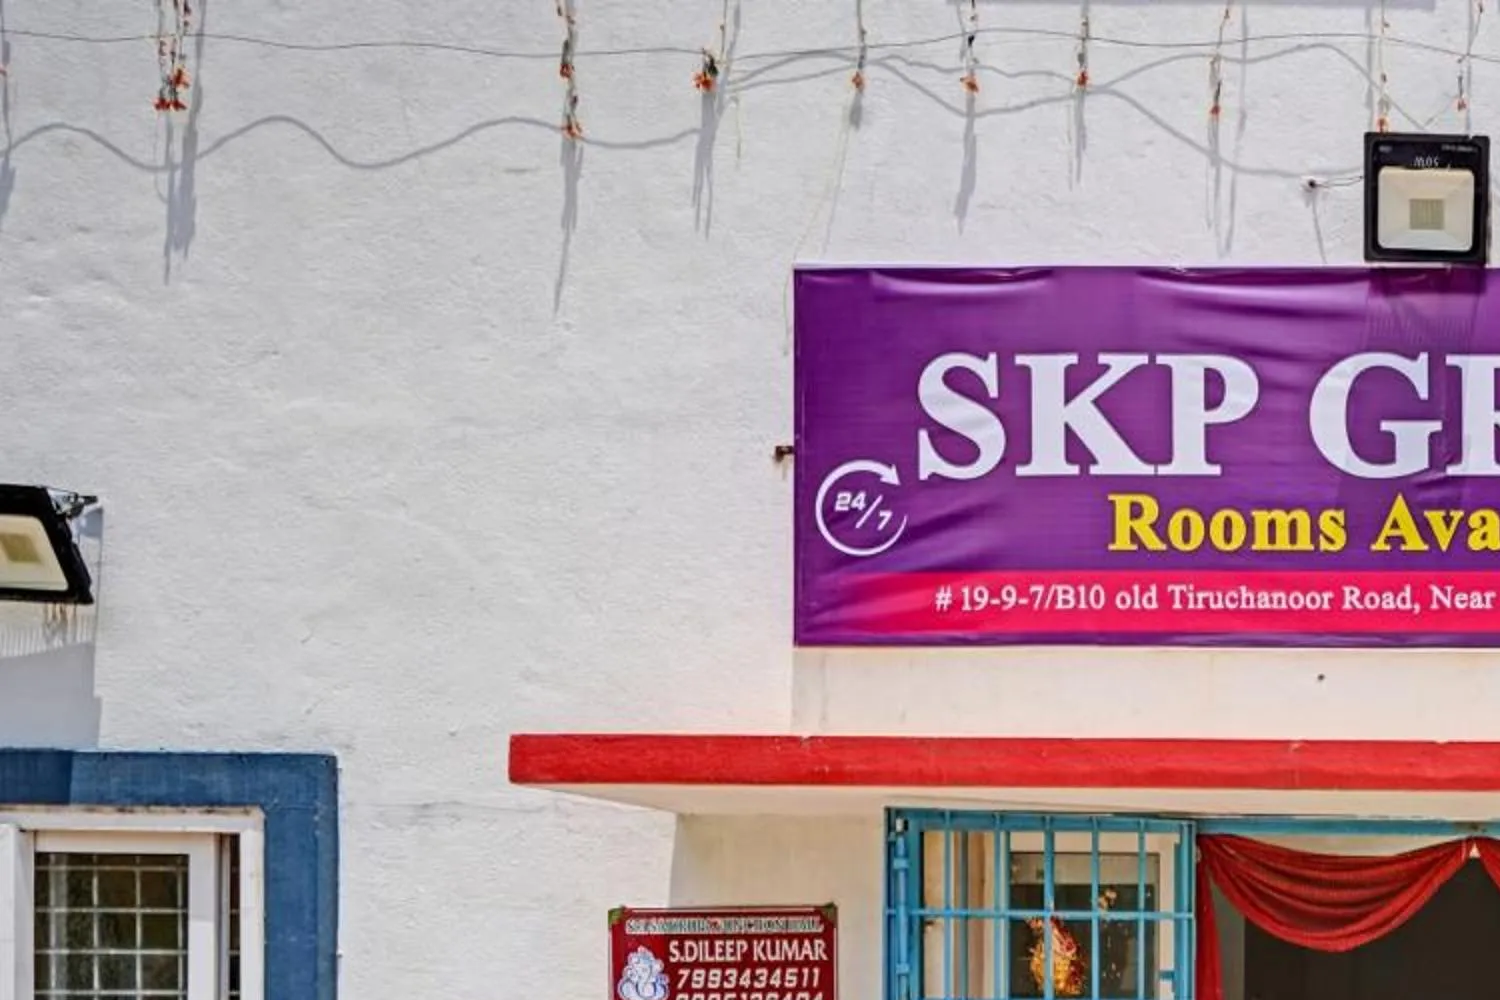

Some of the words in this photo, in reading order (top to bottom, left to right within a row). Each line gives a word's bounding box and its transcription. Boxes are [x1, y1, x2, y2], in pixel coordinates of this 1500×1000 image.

[917, 352, 1260, 481] SKP
[834, 491, 892, 532] 24/7
[1108, 493, 1347, 553] Rooms
[935, 586, 952, 612] #
[961, 583, 1106, 612] 19-9-7/B10
[1115, 584, 1159, 611] old
[1167, 584, 1334, 611] Tiruchanoor
[1343, 584, 1422, 615] Road,
[1430, 584, 1497, 610] Near
[669, 939, 748, 963] S.DILEEP
[753, 939, 829, 962] KUMAR
[676, 967, 821, 990] 7993434511
